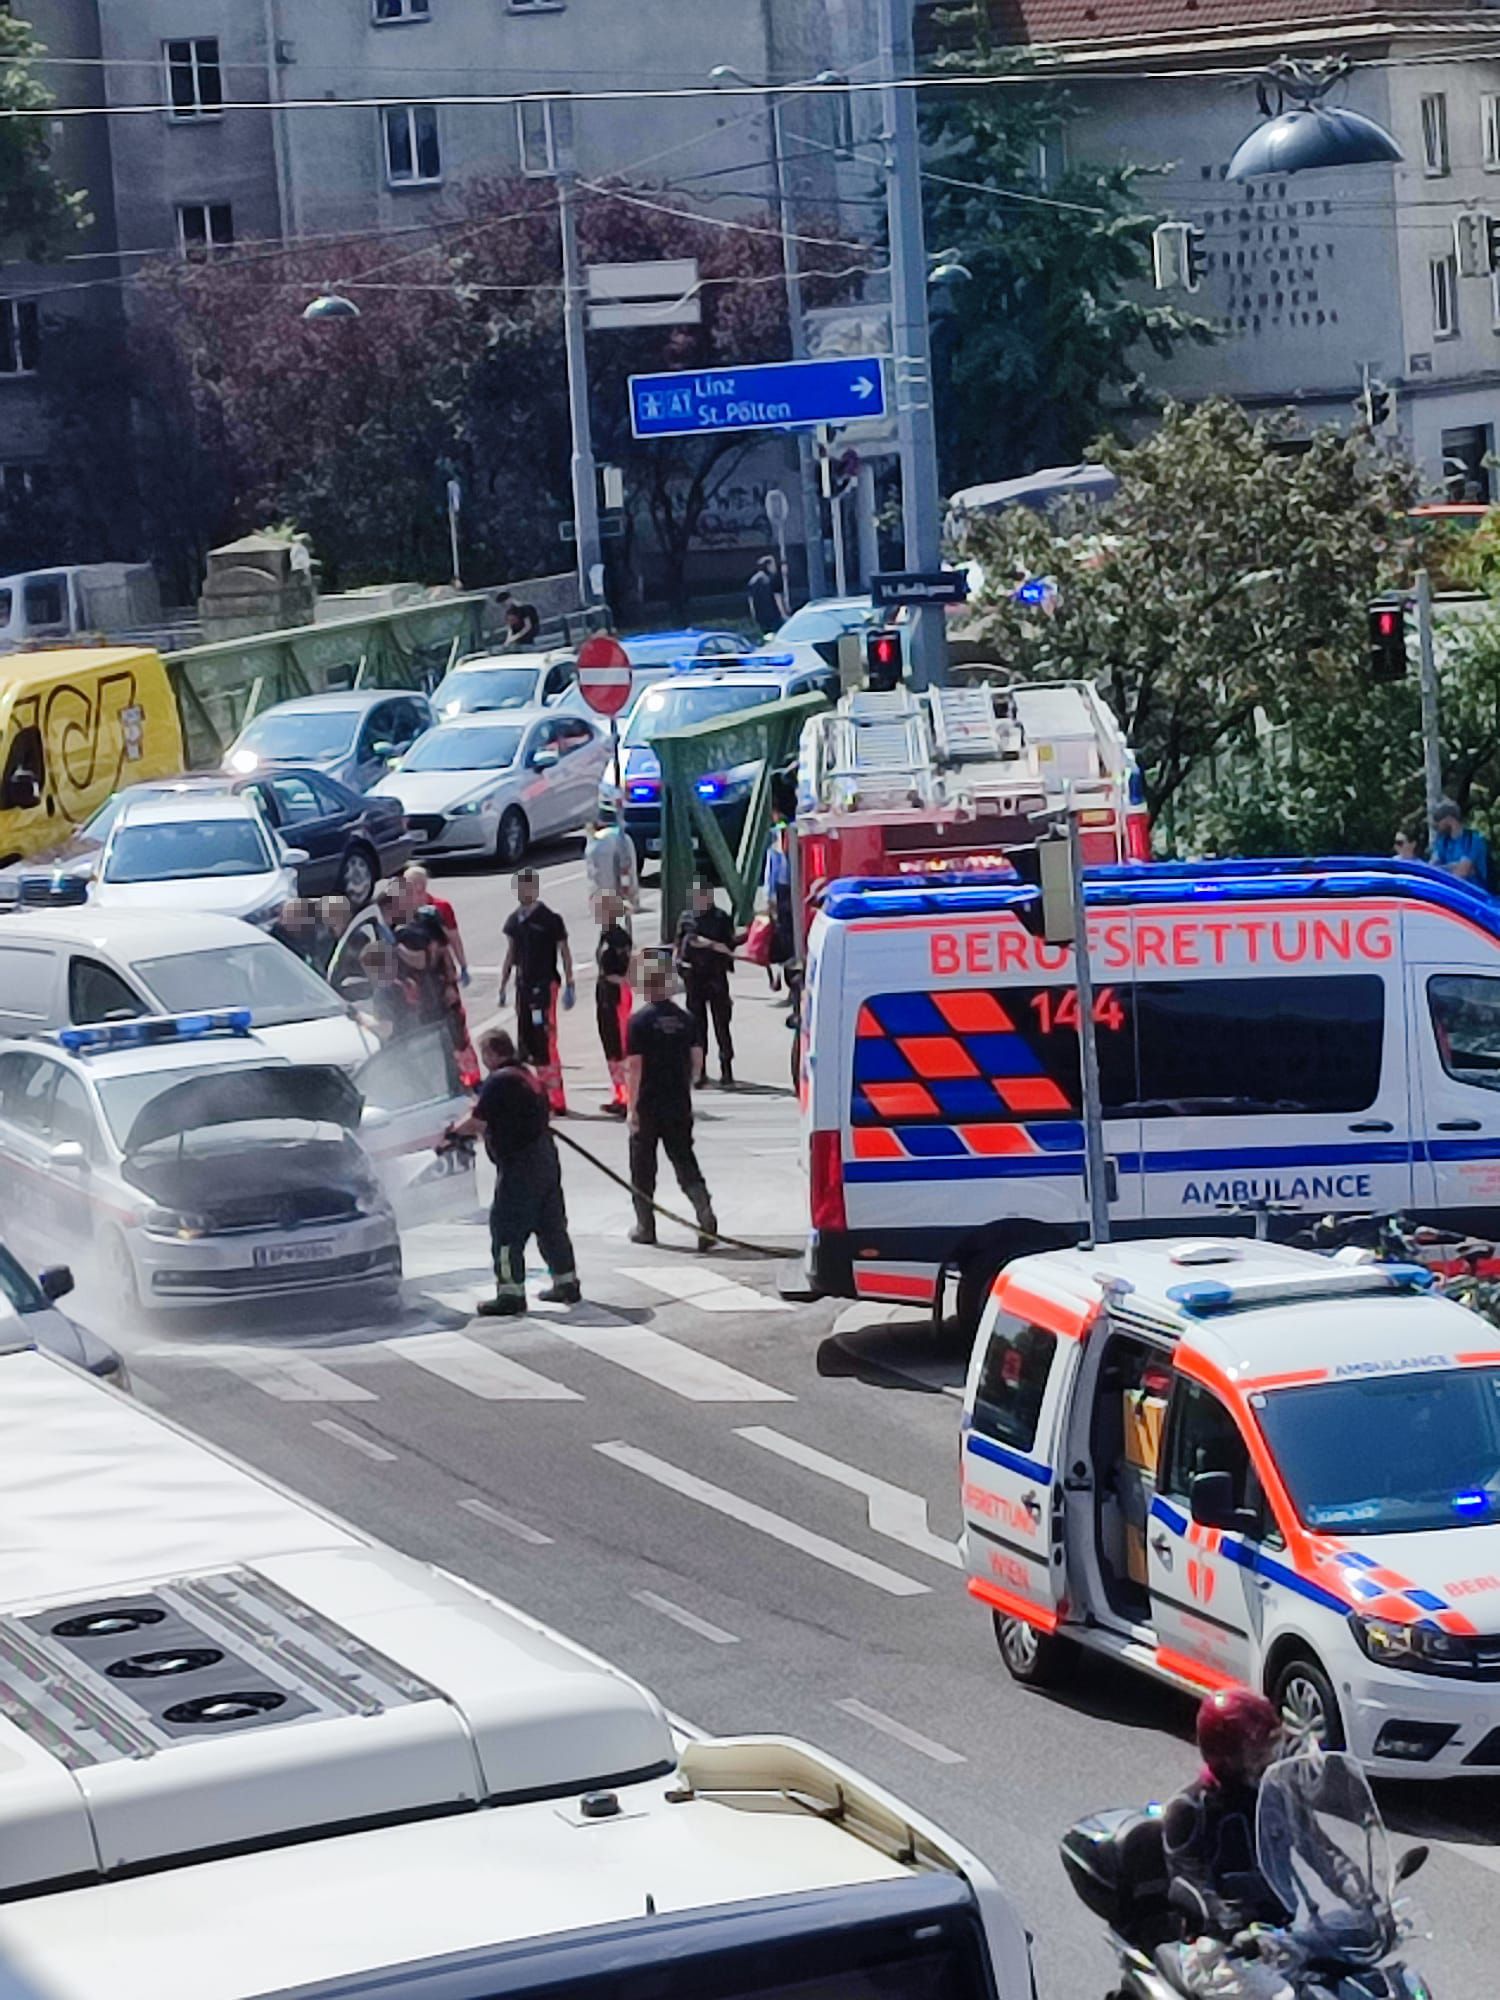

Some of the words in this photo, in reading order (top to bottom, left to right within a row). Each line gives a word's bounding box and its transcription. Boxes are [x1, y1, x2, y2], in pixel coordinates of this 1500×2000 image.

[694, 377, 735, 398] Linz
[670, 394, 692, 414] A1
[1030, 987, 1125, 1034] 144
[1182, 1174, 1372, 1204] AMBULANCE
[1335, 1353, 1450, 1377] AMBULANCE
